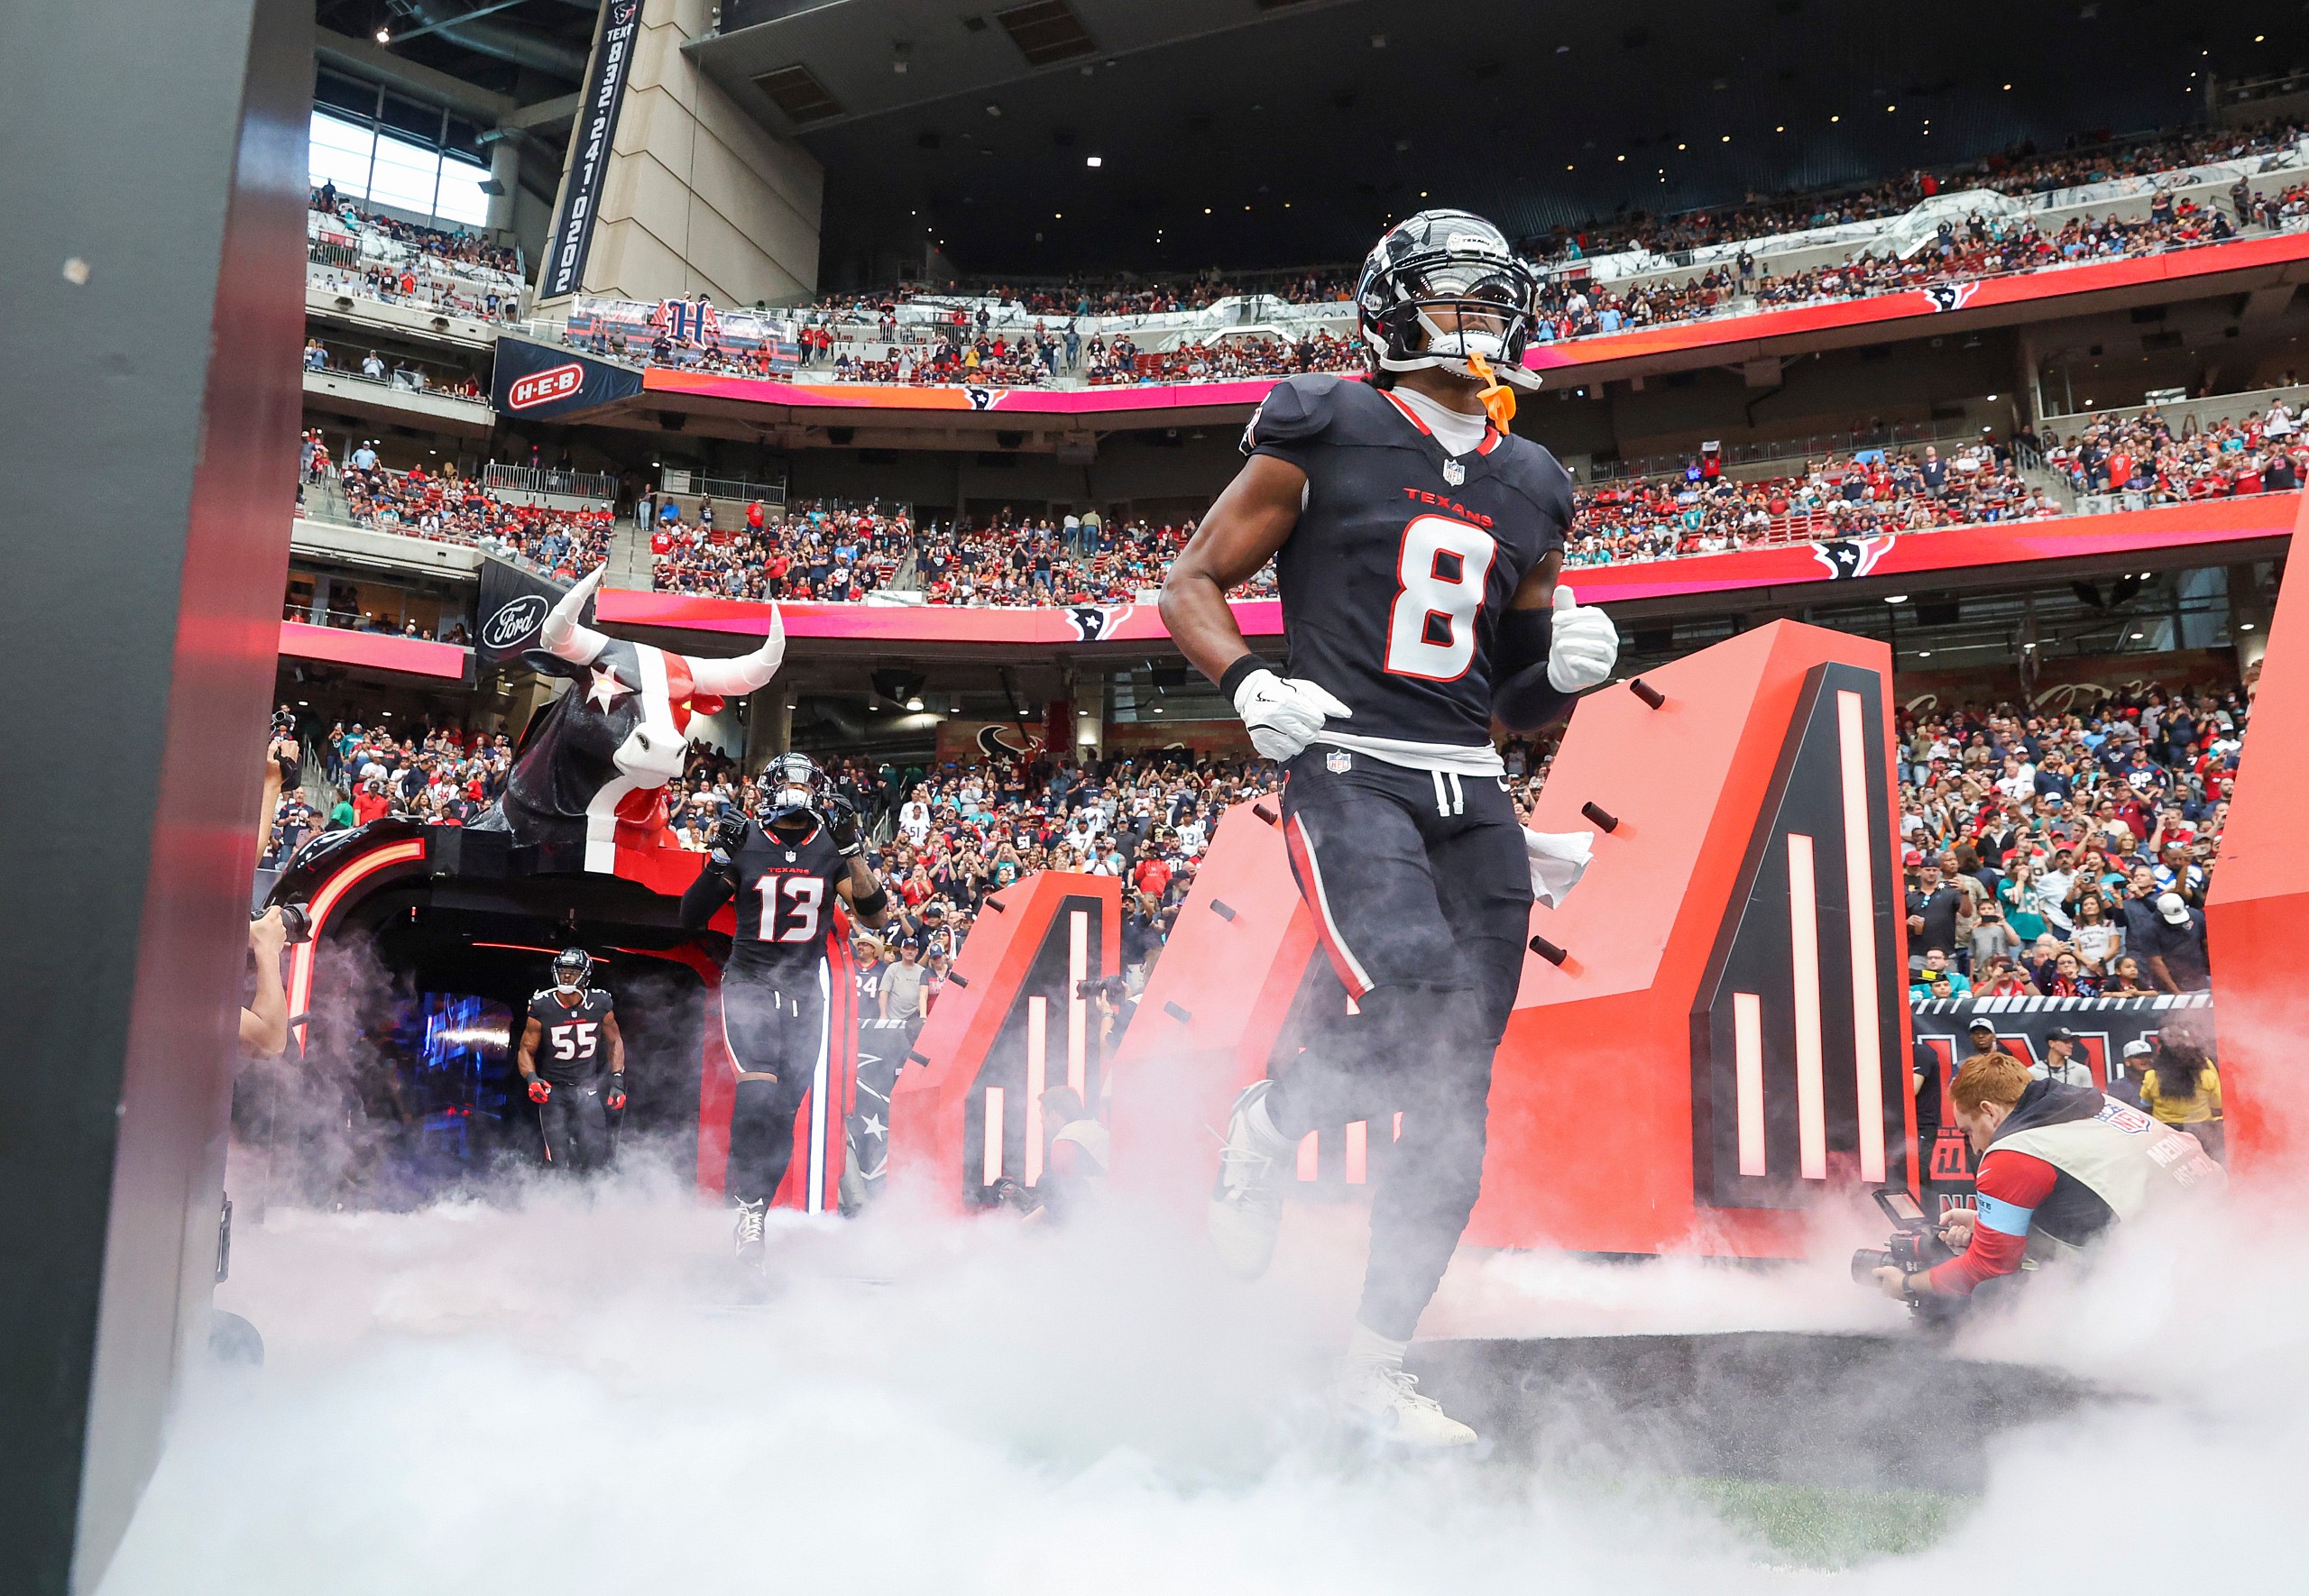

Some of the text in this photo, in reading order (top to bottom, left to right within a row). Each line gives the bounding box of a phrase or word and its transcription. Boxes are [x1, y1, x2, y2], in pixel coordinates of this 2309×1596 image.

[607, 23, 634, 42] TEXT
[1446, 469, 1462, 482] NFL
[1928, 462, 1937, 473] 7
[1403, 486, 1494, 527] TEXANS
[1384, 513, 1498, 683] 8
[494, 603, 536, 643] Ford
[1330, 760, 1349, 770] NFL
[699, 769, 706, 779] 7
[458, 806, 469, 819] 7
[909, 827, 920, 838] 51
[1180, 833, 1195, 846] 13
[1017, 835, 1031, 849] 51
[768, 867, 811, 876] TEXANS
[939, 867, 948, 884] 7
[752, 874, 826, 944] 13
[887, 924, 900, 944] 7
[550, 1023, 598, 1060] 55
[2110, 1111, 2146, 1131] NFL
[2146, 1133, 2193, 1168] MEDIA
